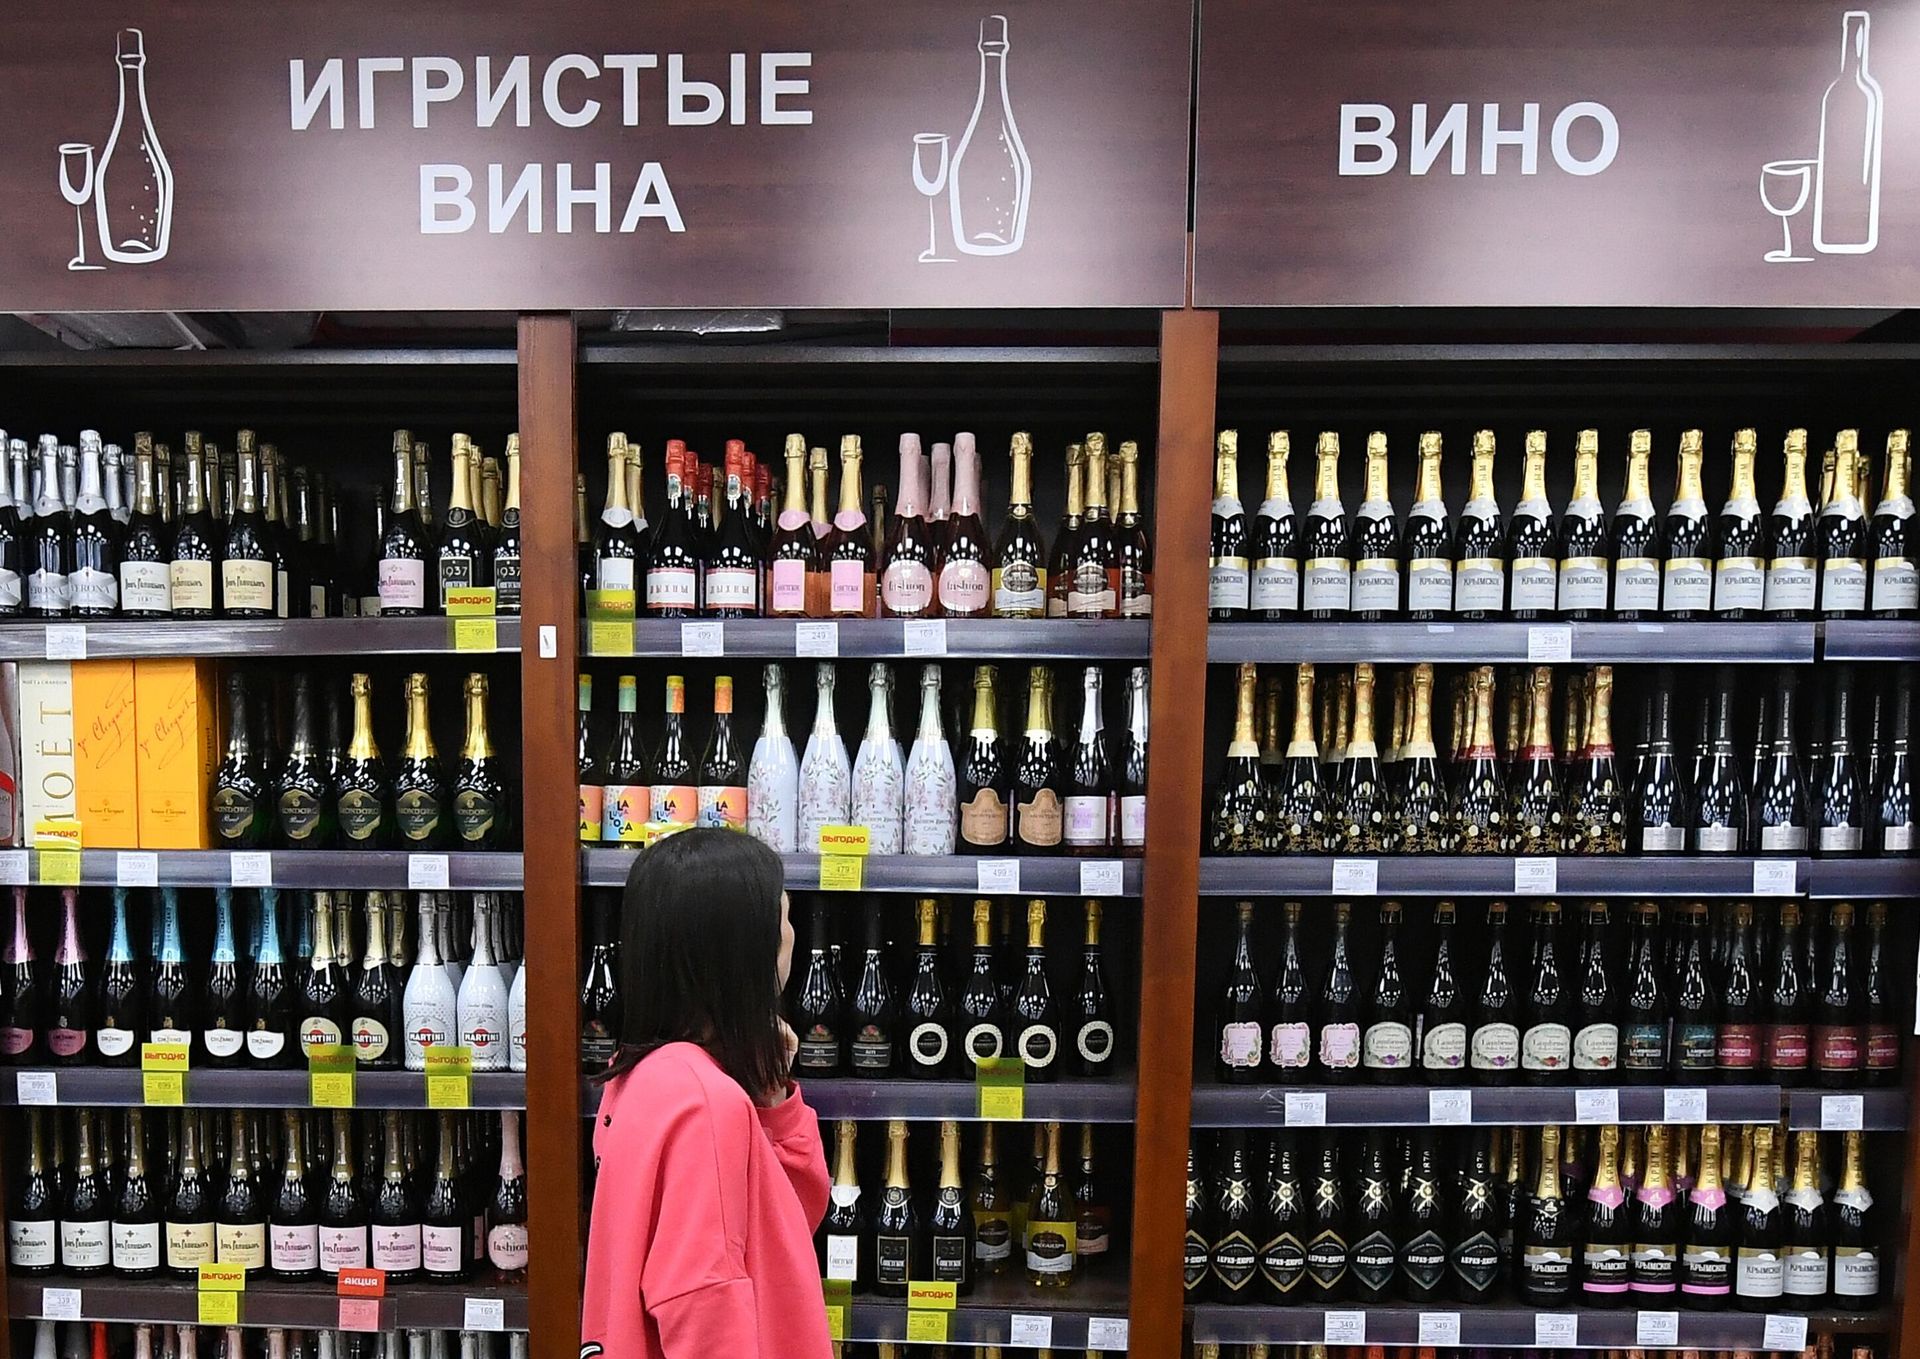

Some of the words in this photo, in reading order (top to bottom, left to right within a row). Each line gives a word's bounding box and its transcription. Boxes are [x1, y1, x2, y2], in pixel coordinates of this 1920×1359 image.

[289, 52, 813, 130] ИГРИСТЫЕ
[1338, 102, 1620, 176] ВИНО
[419, 162, 686, 234] ВИНА
[442, 566, 468, 577] 1937
[448, 596, 492, 605] ВЫГОДНО
[811, 630, 826, 640] 249
[617, 800, 630, 811] LA
[664, 800, 676, 811] LA
[716, 800, 728, 812] LA
[822, 836, 866, 844] ВЫГОДНО
[1349, 868, 1364, 878] 599
[1530, 868, 1544, 876] 599
[1768, 870, 1782, 878] 599
[410, 1032, 444, 1040] MARTINI
[464, 1032, 498, 1040] MARTINI
[144, 1052, 186, 1060] ВЫГОДНО
[428, 1056, 469, 1064] ВЫГОДНО
[1300, 1102, 1314, 1110] 199
[1444, 1100, 1458, 1108] 299
[1591, 1098, 1606, 1107] 299
[1679, 1098, 1694, 1107] 299
[1836, 1104, 1850, 1112] 299
[344, 1277, 378, 1286] АКЦИЯ
[911, 1290, 953, 1299] ВЫГОДНО
[1340, 1320, 1354, 1329] 349
[1434, 1322, 1448, 1330] 349
[1550, 1324, 1565, 1332] 289
